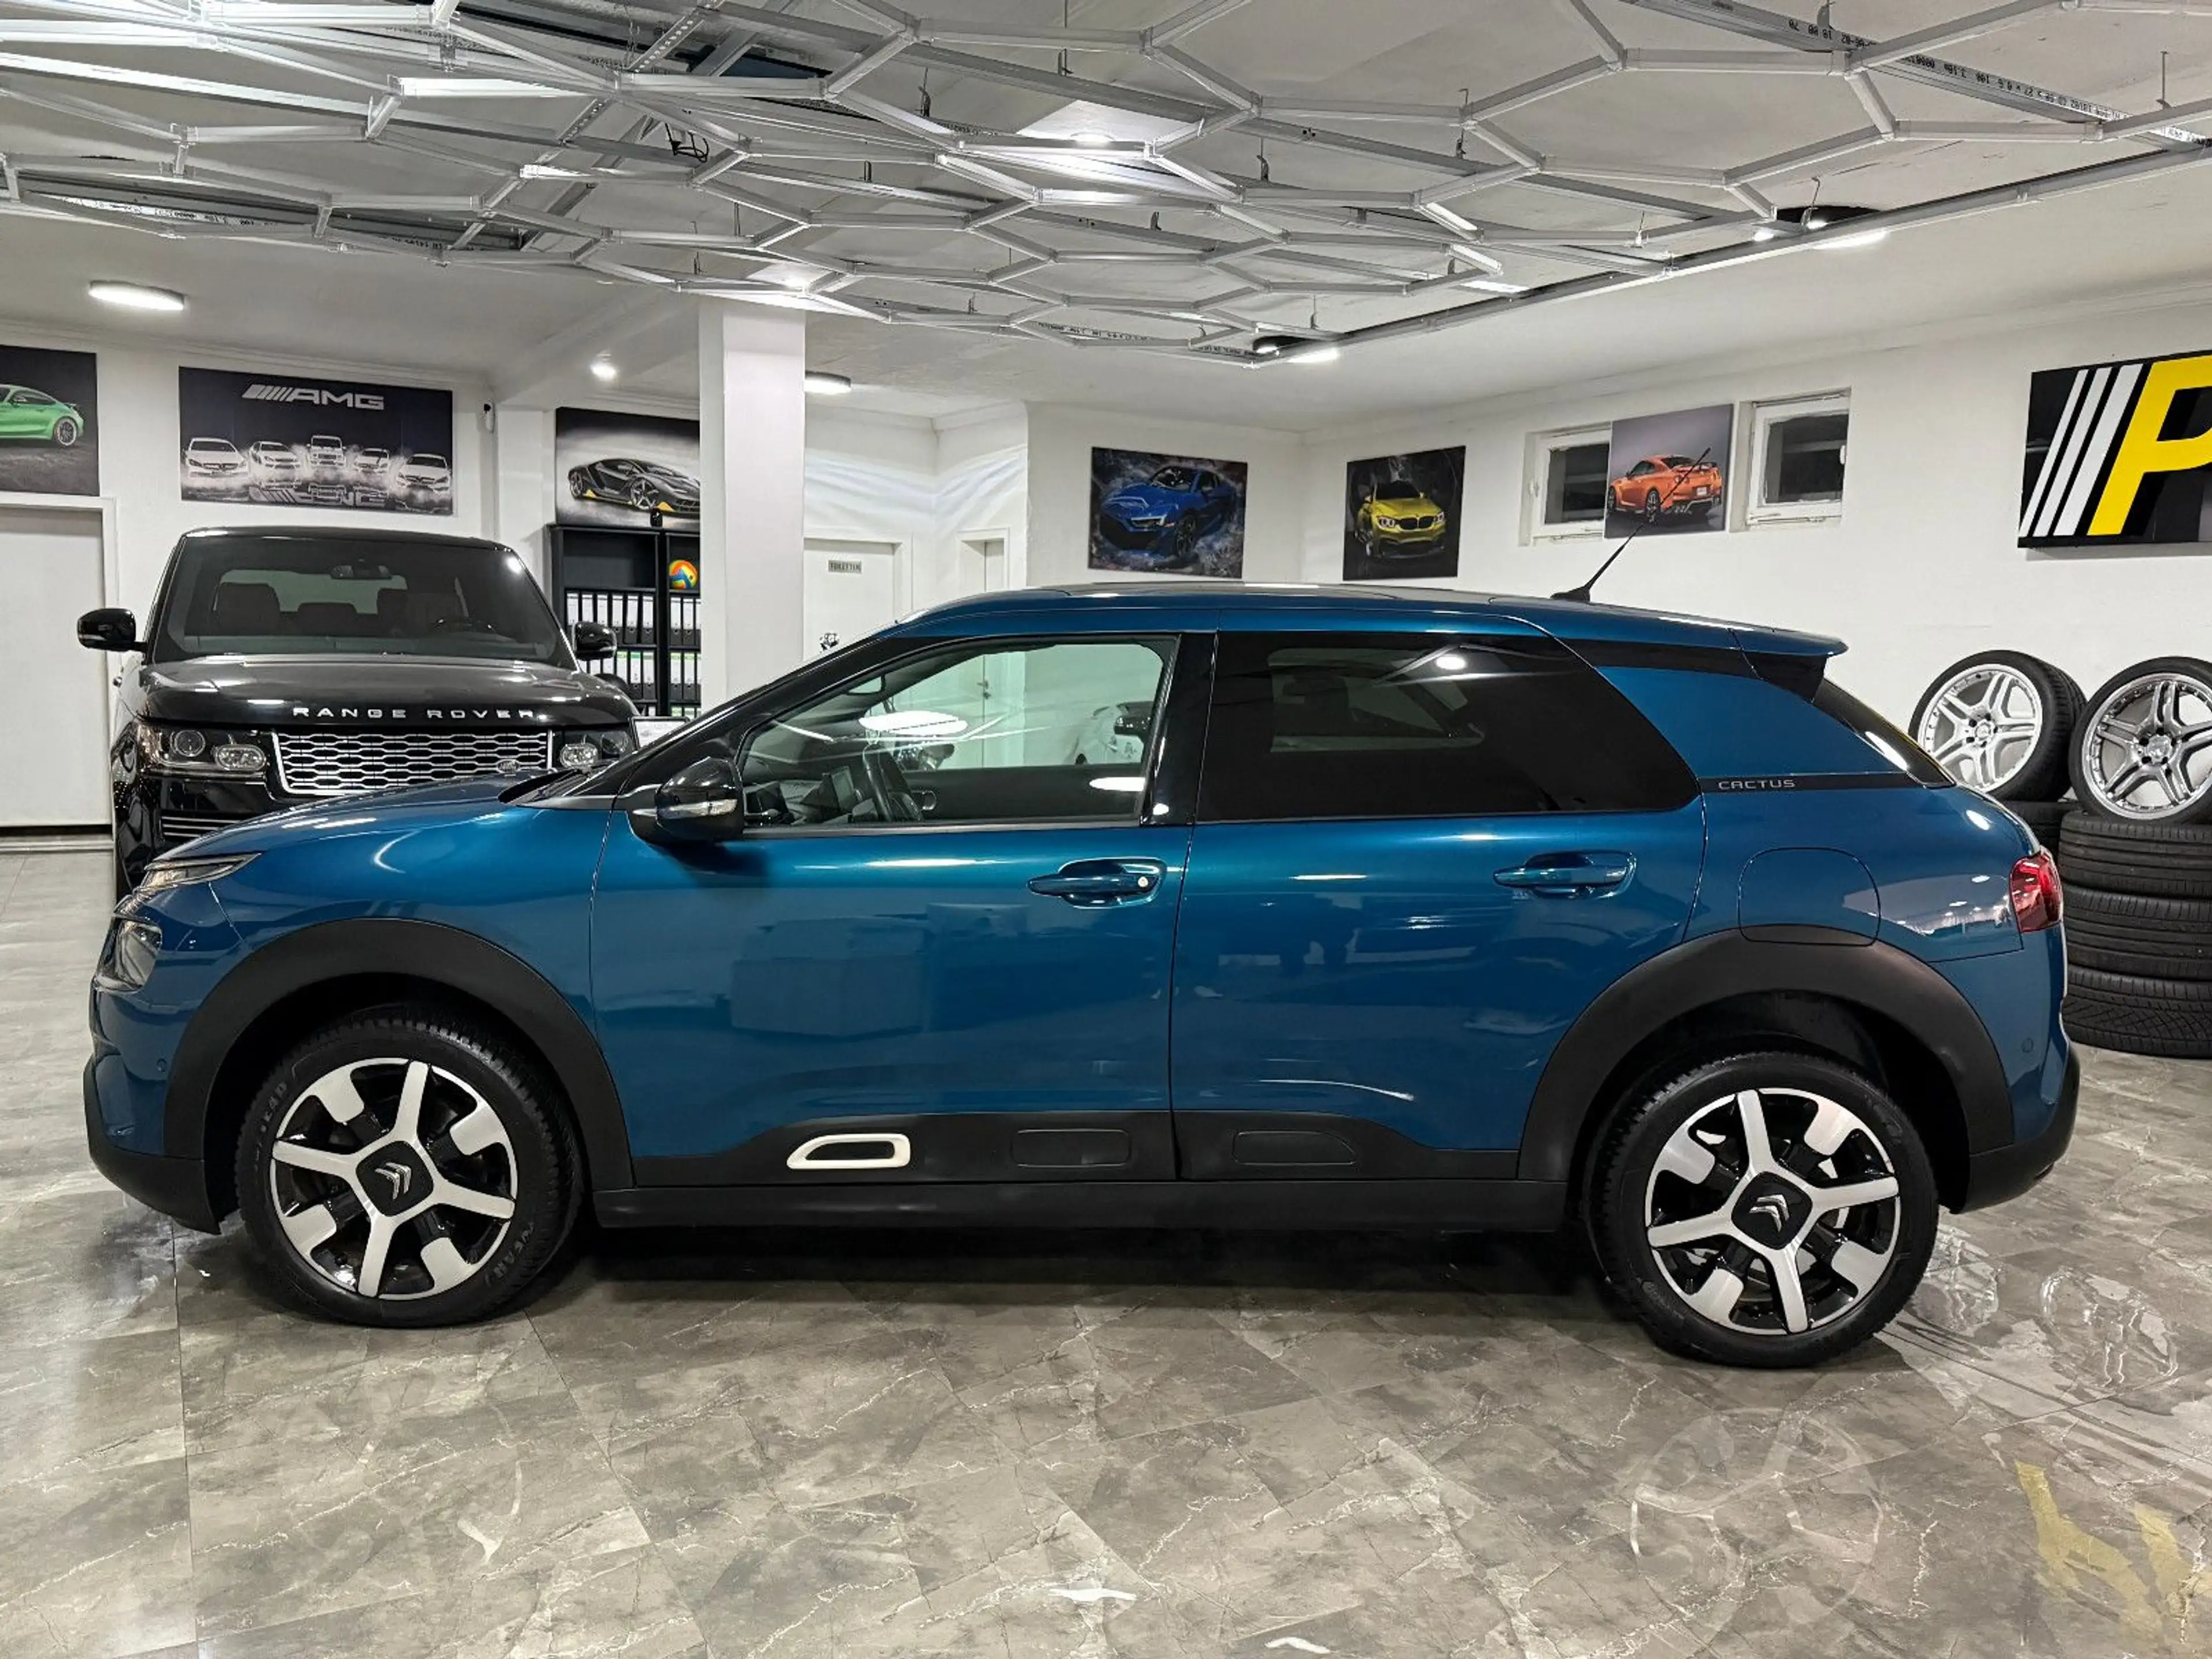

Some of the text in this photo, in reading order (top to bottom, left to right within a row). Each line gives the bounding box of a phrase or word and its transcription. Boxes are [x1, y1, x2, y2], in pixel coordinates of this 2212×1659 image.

[286, 387, 385, 410] AMG
[293, 707, 533, 719] RANGE ROVER
[1718, 779, 1796, 790] CACTUS
